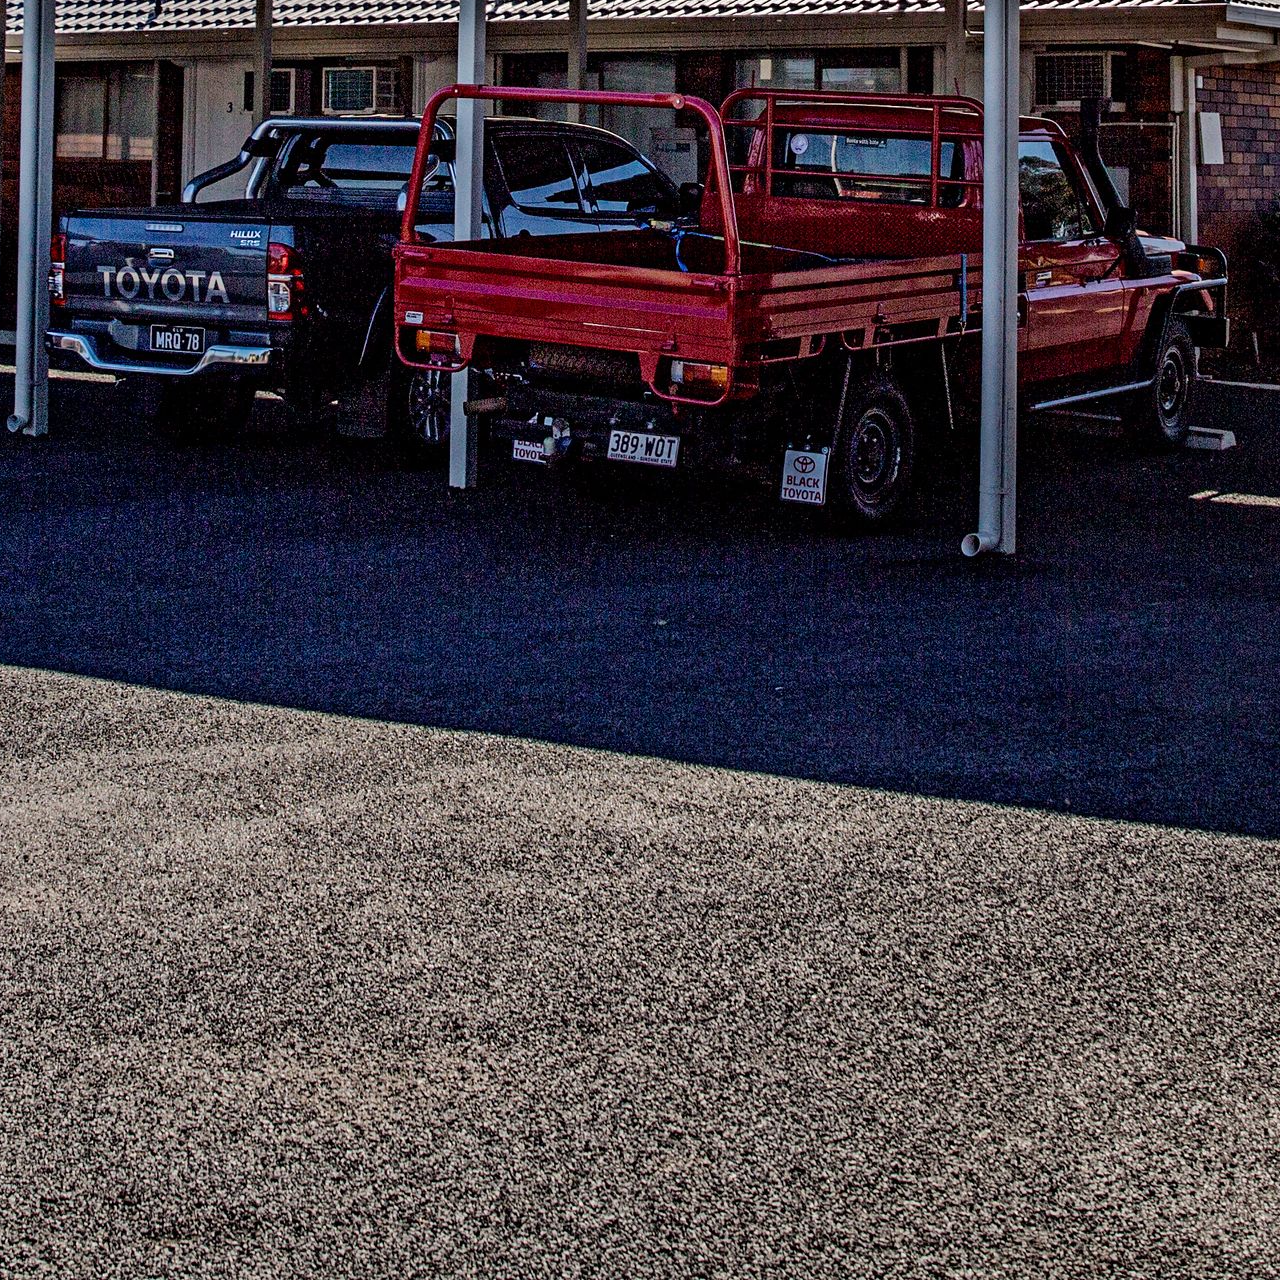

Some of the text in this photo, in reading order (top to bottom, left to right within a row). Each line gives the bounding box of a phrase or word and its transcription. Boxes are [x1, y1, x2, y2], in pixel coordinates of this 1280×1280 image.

[226, 101, 233, 113] 3
[230, 230, 262, 239] HILUX
[96, 265, 230, 304] TOYOTA
[514, 447, 544, 460] TOYOT
[786, 475, 820, 489] BLACK
[783, 487, 822, 502] TOYOTA
